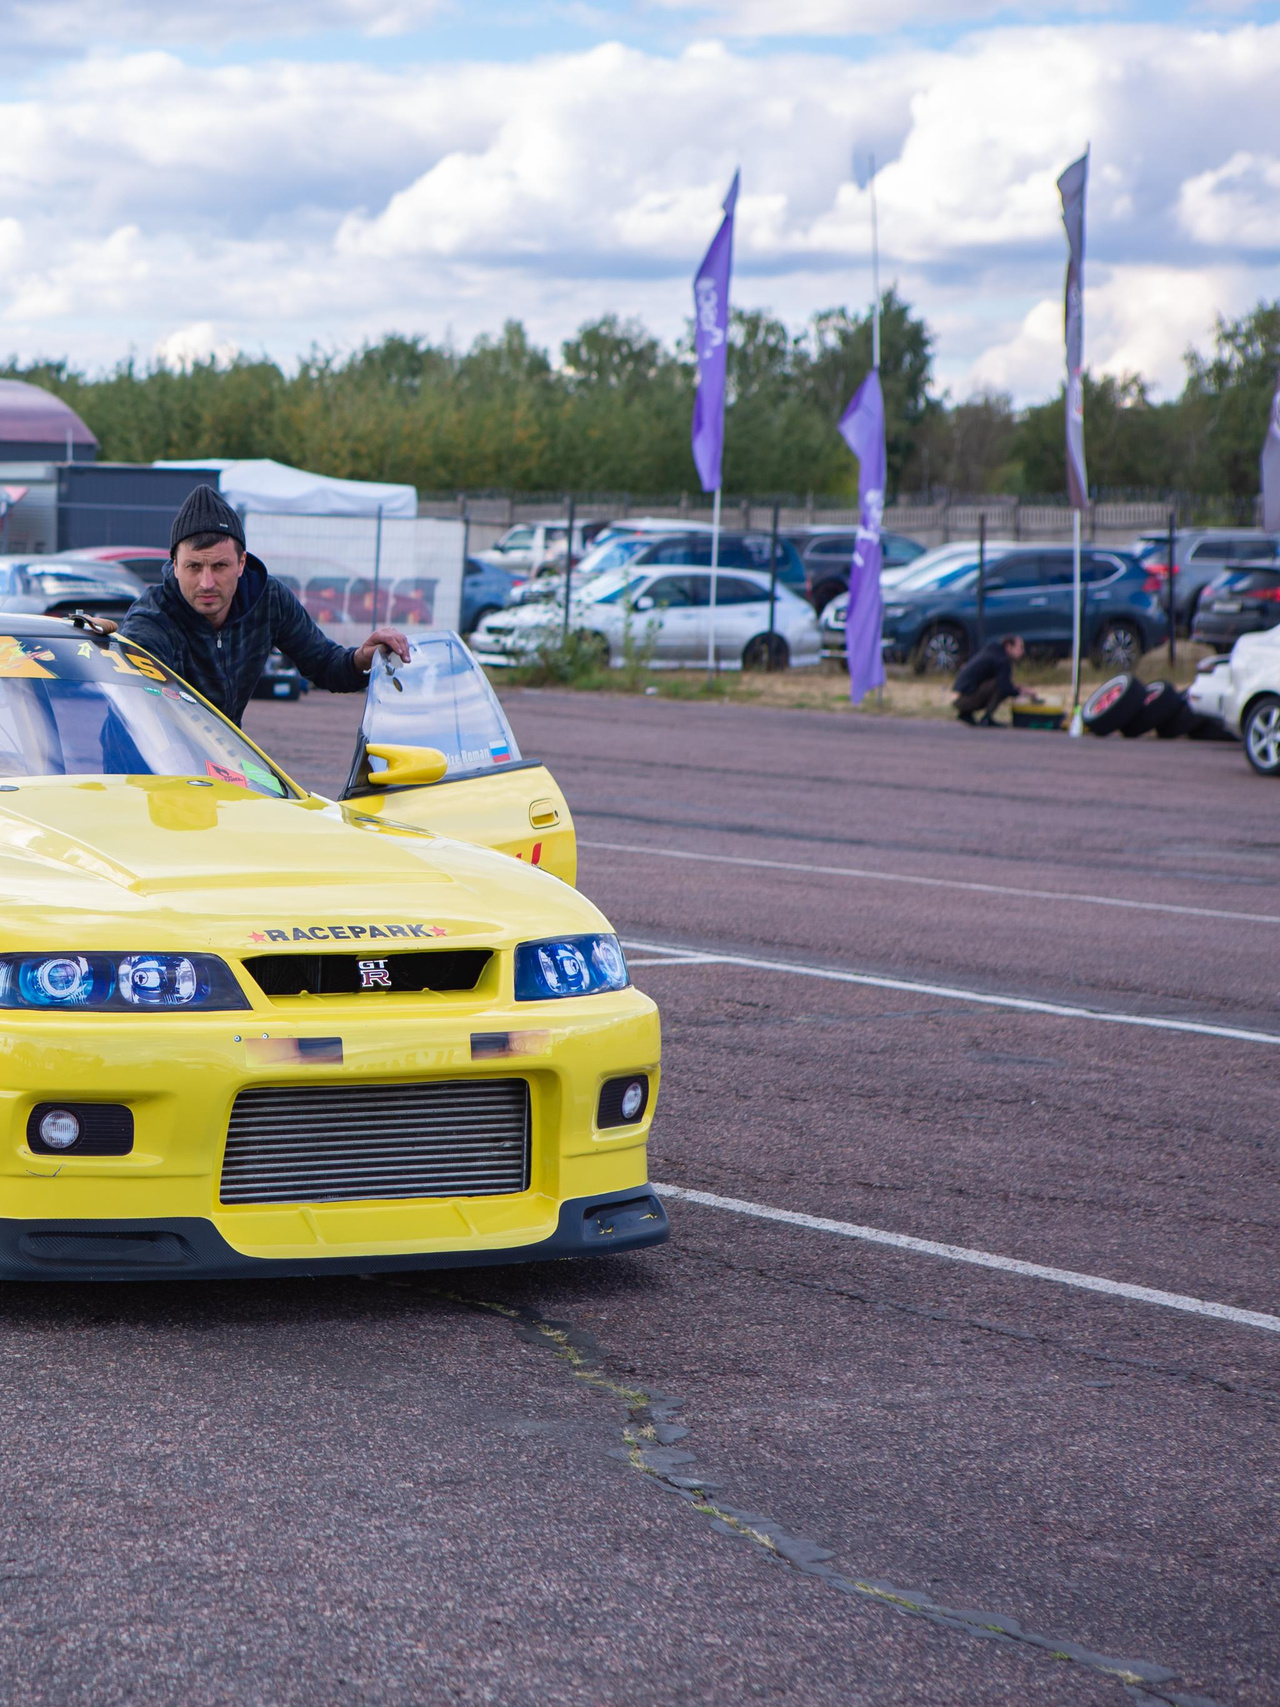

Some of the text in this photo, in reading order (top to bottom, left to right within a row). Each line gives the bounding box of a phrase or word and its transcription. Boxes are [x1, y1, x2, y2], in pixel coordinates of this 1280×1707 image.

[100, 649, 167, 682] 15
[264, 924, 434, 942] RACEPARK
[358, 959, 389, 970] GT
[360, 969, 392, 988] R
